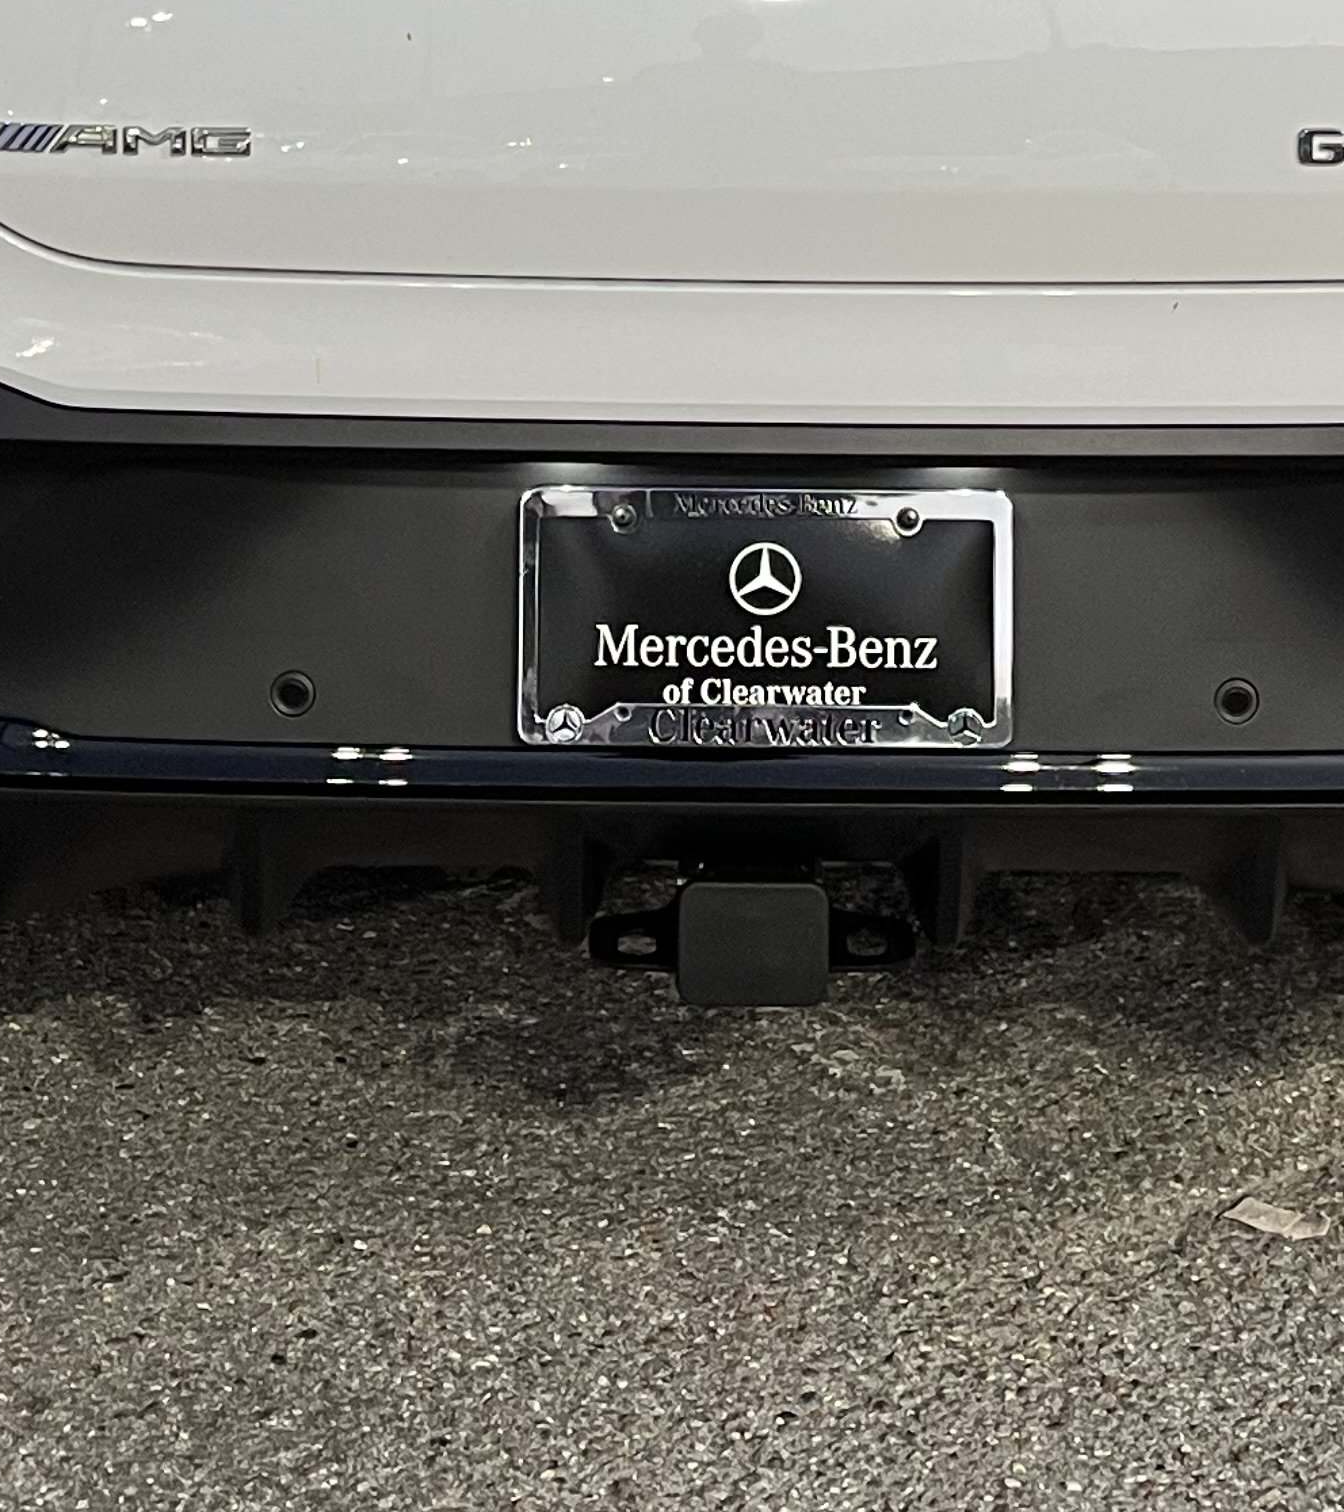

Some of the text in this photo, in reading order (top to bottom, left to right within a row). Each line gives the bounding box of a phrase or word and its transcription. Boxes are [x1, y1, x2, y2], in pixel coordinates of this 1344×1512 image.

[49, 123, 252, 157] AMG
[674, 493, 859, 519] Mercedes-Benz
[593, 623, 939, 670] Mercedes-Benz
[662, 677, 867, 706] of Clearwater
[647, 707, 883, 746] Clearwater
